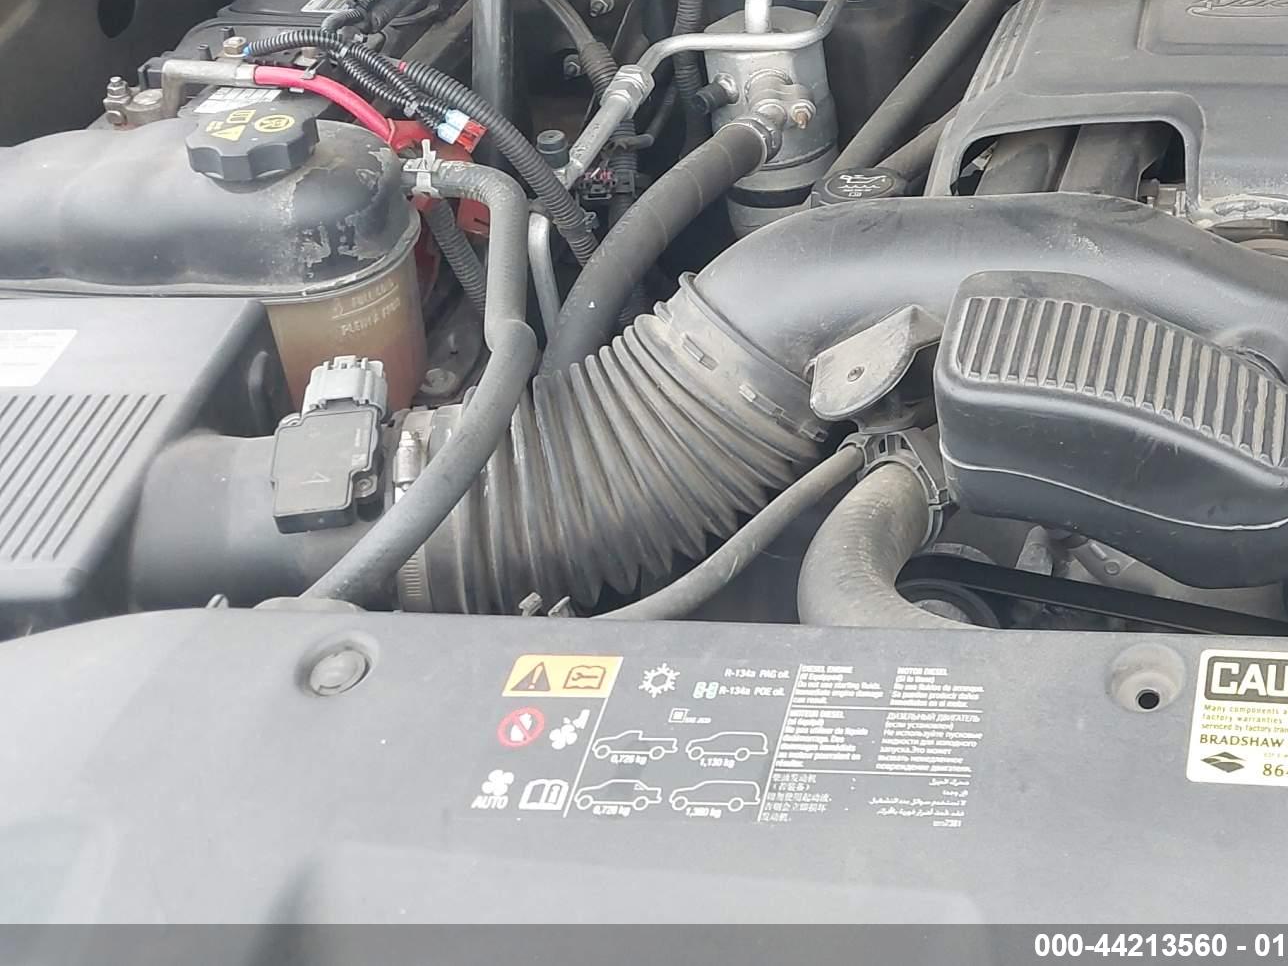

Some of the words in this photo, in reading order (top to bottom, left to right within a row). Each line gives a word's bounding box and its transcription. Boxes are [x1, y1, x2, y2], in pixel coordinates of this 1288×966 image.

[724, 668, 756, 679] R-134a
[718, 687, 751, 696] R-134a
[1204, 704, 1226, 713] Many
[1229, 706, 1279, 715] components
[1199, 733, 1284, 748] BRADSHAW
[471, 795, 509, 810] AUTO
